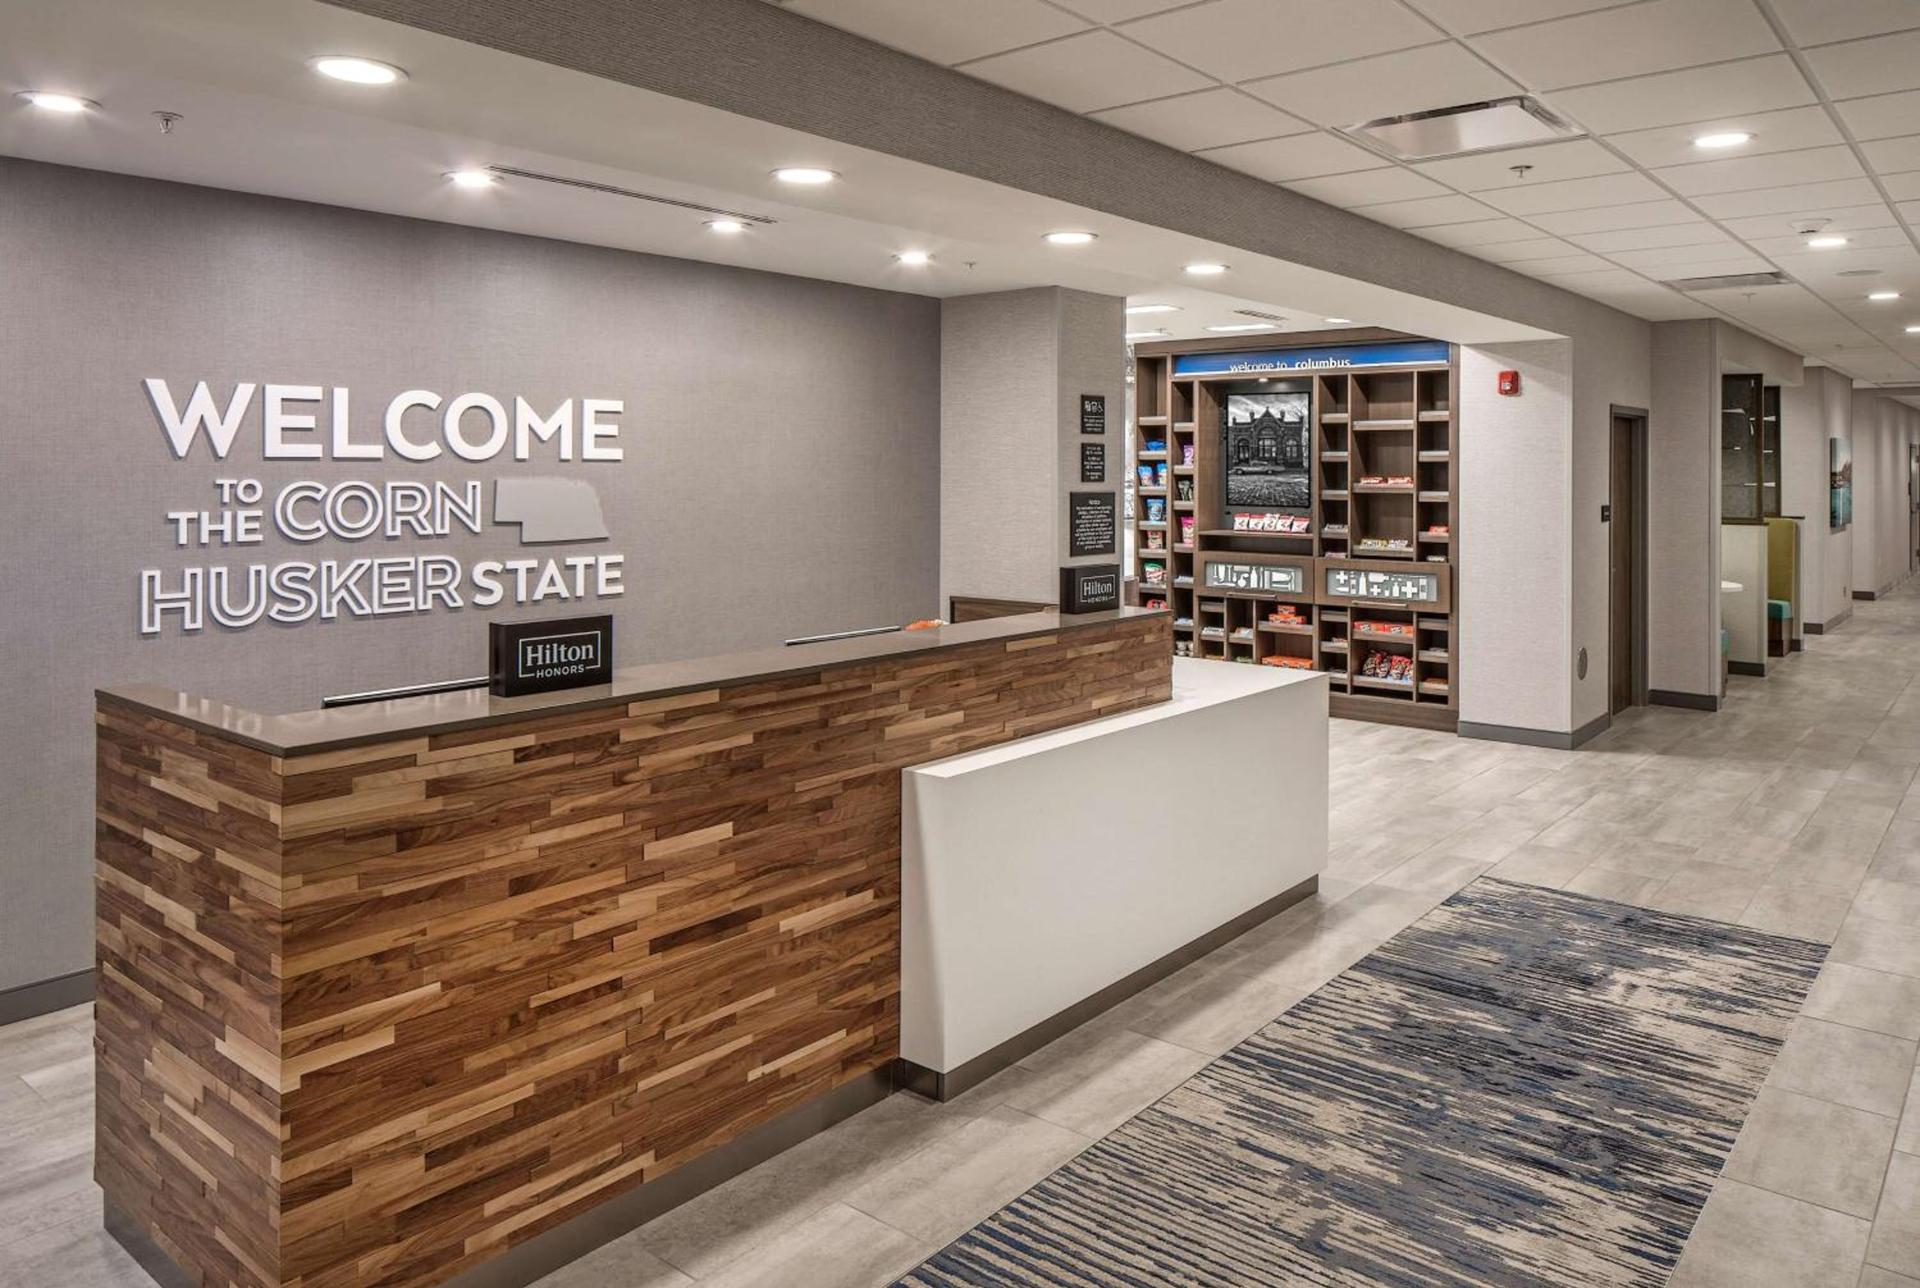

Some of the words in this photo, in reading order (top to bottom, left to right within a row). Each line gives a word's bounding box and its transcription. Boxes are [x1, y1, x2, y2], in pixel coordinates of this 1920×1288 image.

[1230, 362, 1274, 372] welcome
[1277, 360, 1288, 370] to
[1295, 357, 1350, 369] columbus
[144, 378, 624, 460] WELCOME
[215, 479, 263, 504] TO
[274, 479, 481, 541] CORN
[167, 510, 263, 545] THE
[140, 554, 463, 634] HUSKER
[473, 555, 624, 606] STATE
[1083, 581, 1112, 596] Hilton
[526, 643, 594, 667] Hilton
[536, 664, 585, 679] HONORS
